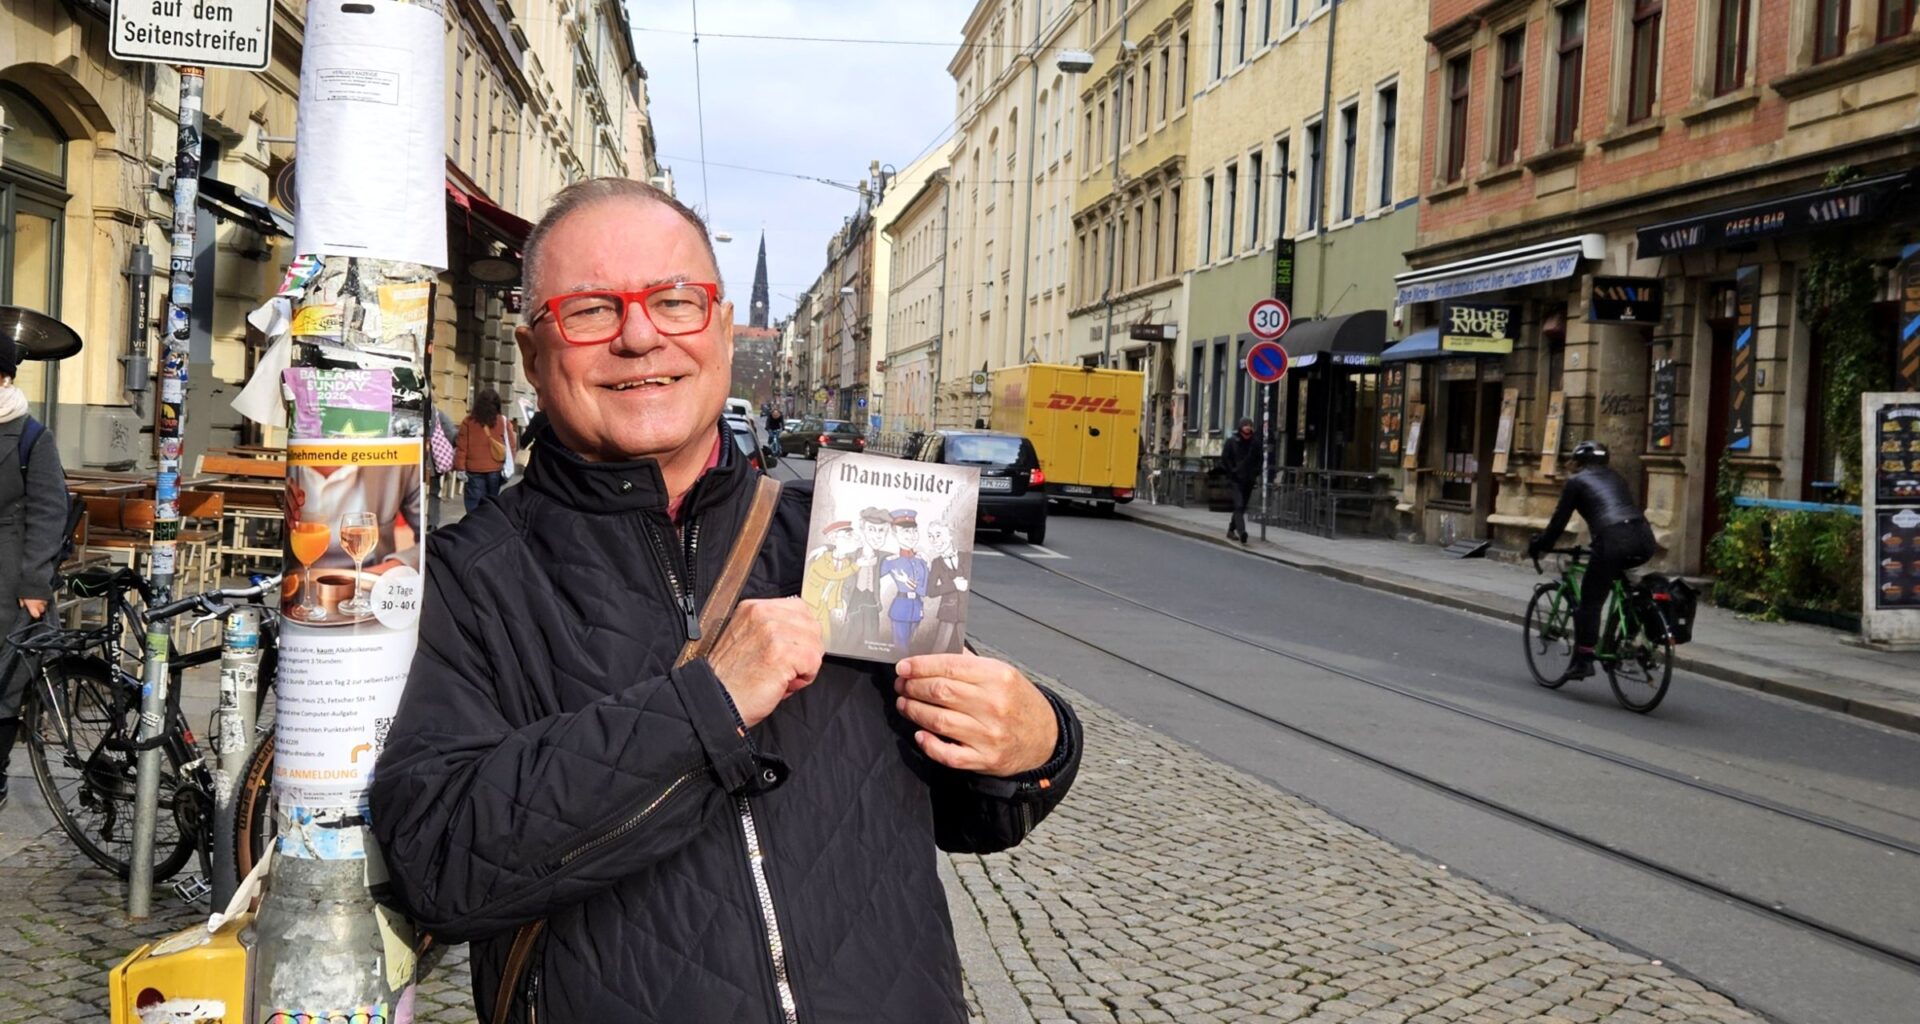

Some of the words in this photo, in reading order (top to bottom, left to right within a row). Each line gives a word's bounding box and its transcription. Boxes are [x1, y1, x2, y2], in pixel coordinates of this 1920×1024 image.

[152, 0, 183, 17] auf
[193, 0, 233, 22] dem
[124, 21, 257, 53] Seitenstreifen
[1530, 264, 1553, 280] since
[1257, 310, 1280, 328] 30
[299, 370, 372, 381] BALEARIC
[306, 380, 366, 391] SUNDAY
[1047, 393, 1121, 415] DHL
[351, 450, 398, 462] gesucht
[840, 463, 953, 494] Mannsbilder
[388, 585, 394, 595] 2
[396, 585, 414, 598] Tage
[381, 600, 394, 610] 30
[289, 769, 358, 780] ANMELDUNG
